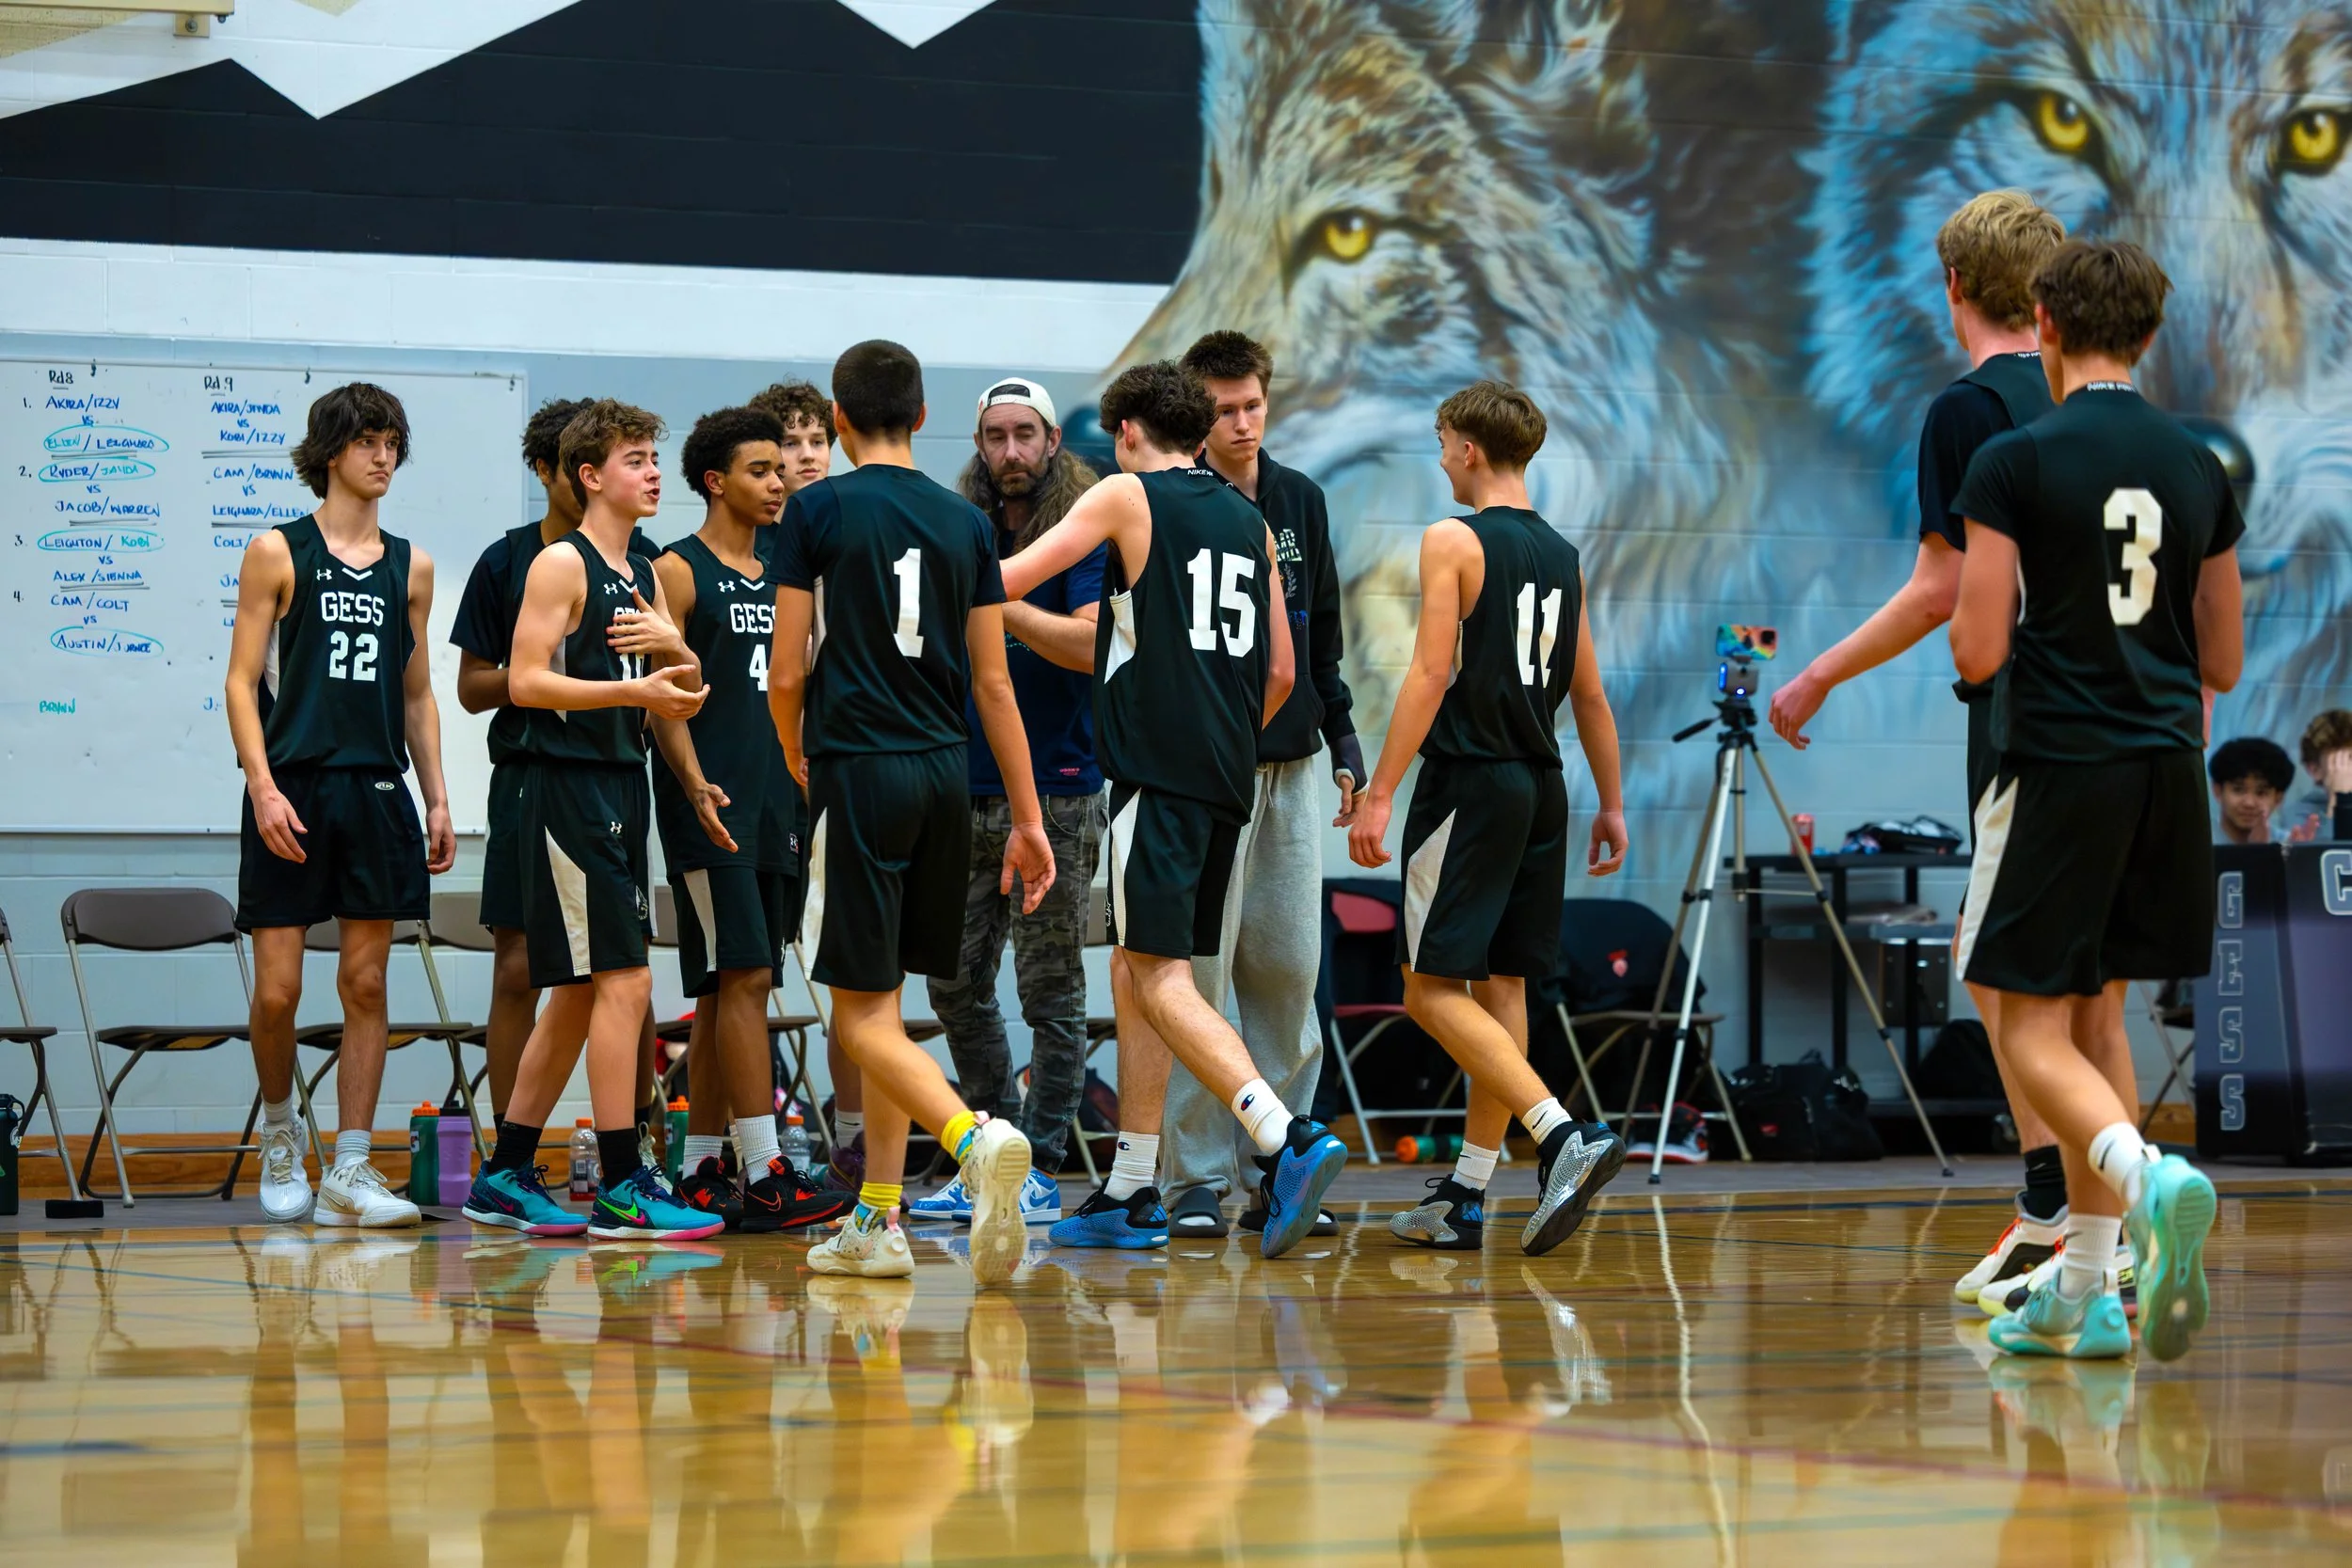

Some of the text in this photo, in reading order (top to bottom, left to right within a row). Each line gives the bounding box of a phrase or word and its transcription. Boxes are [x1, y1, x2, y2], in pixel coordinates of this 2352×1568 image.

[320, 591, 386, 627] GESS
[892, 547, 925, 658] 1
[1186, 547, 1256, 657] 15
[2103, 487, 2164, 627] 3
[328, 630, 379, 682] 22
[729, 603, 777, 634] GES
[748, 643, 770, 691] 4
[1516, 582, 1564, 689] 11
[2217, 870, 2246, 1132] GESS
